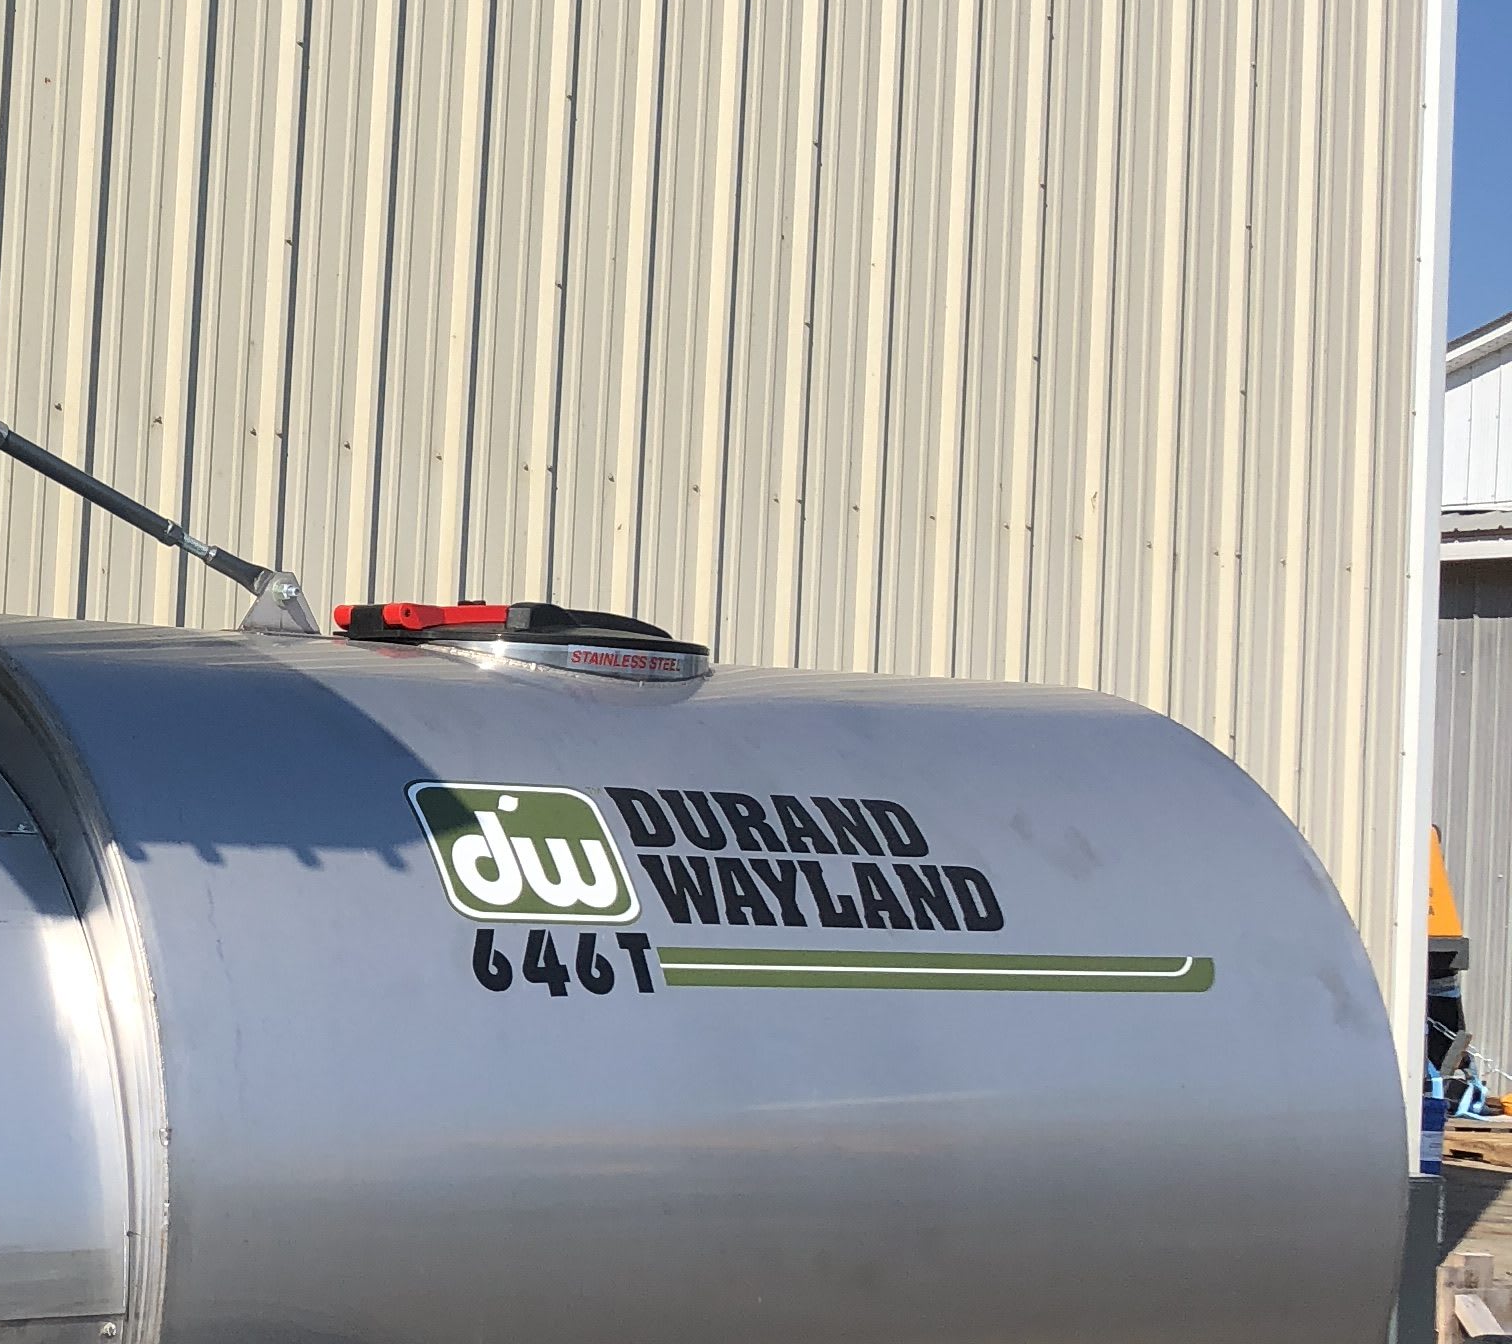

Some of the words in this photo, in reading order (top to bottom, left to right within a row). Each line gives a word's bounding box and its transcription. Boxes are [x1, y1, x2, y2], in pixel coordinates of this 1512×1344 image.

[571, 650, 648, 669] STAINLESS
[649, 656, 681, 672] STEEL
[604, 786, 930, 858] DURAND
[637, 853, 1005, 932] WAYLAND
[472, 928, 655, 997] 646T
